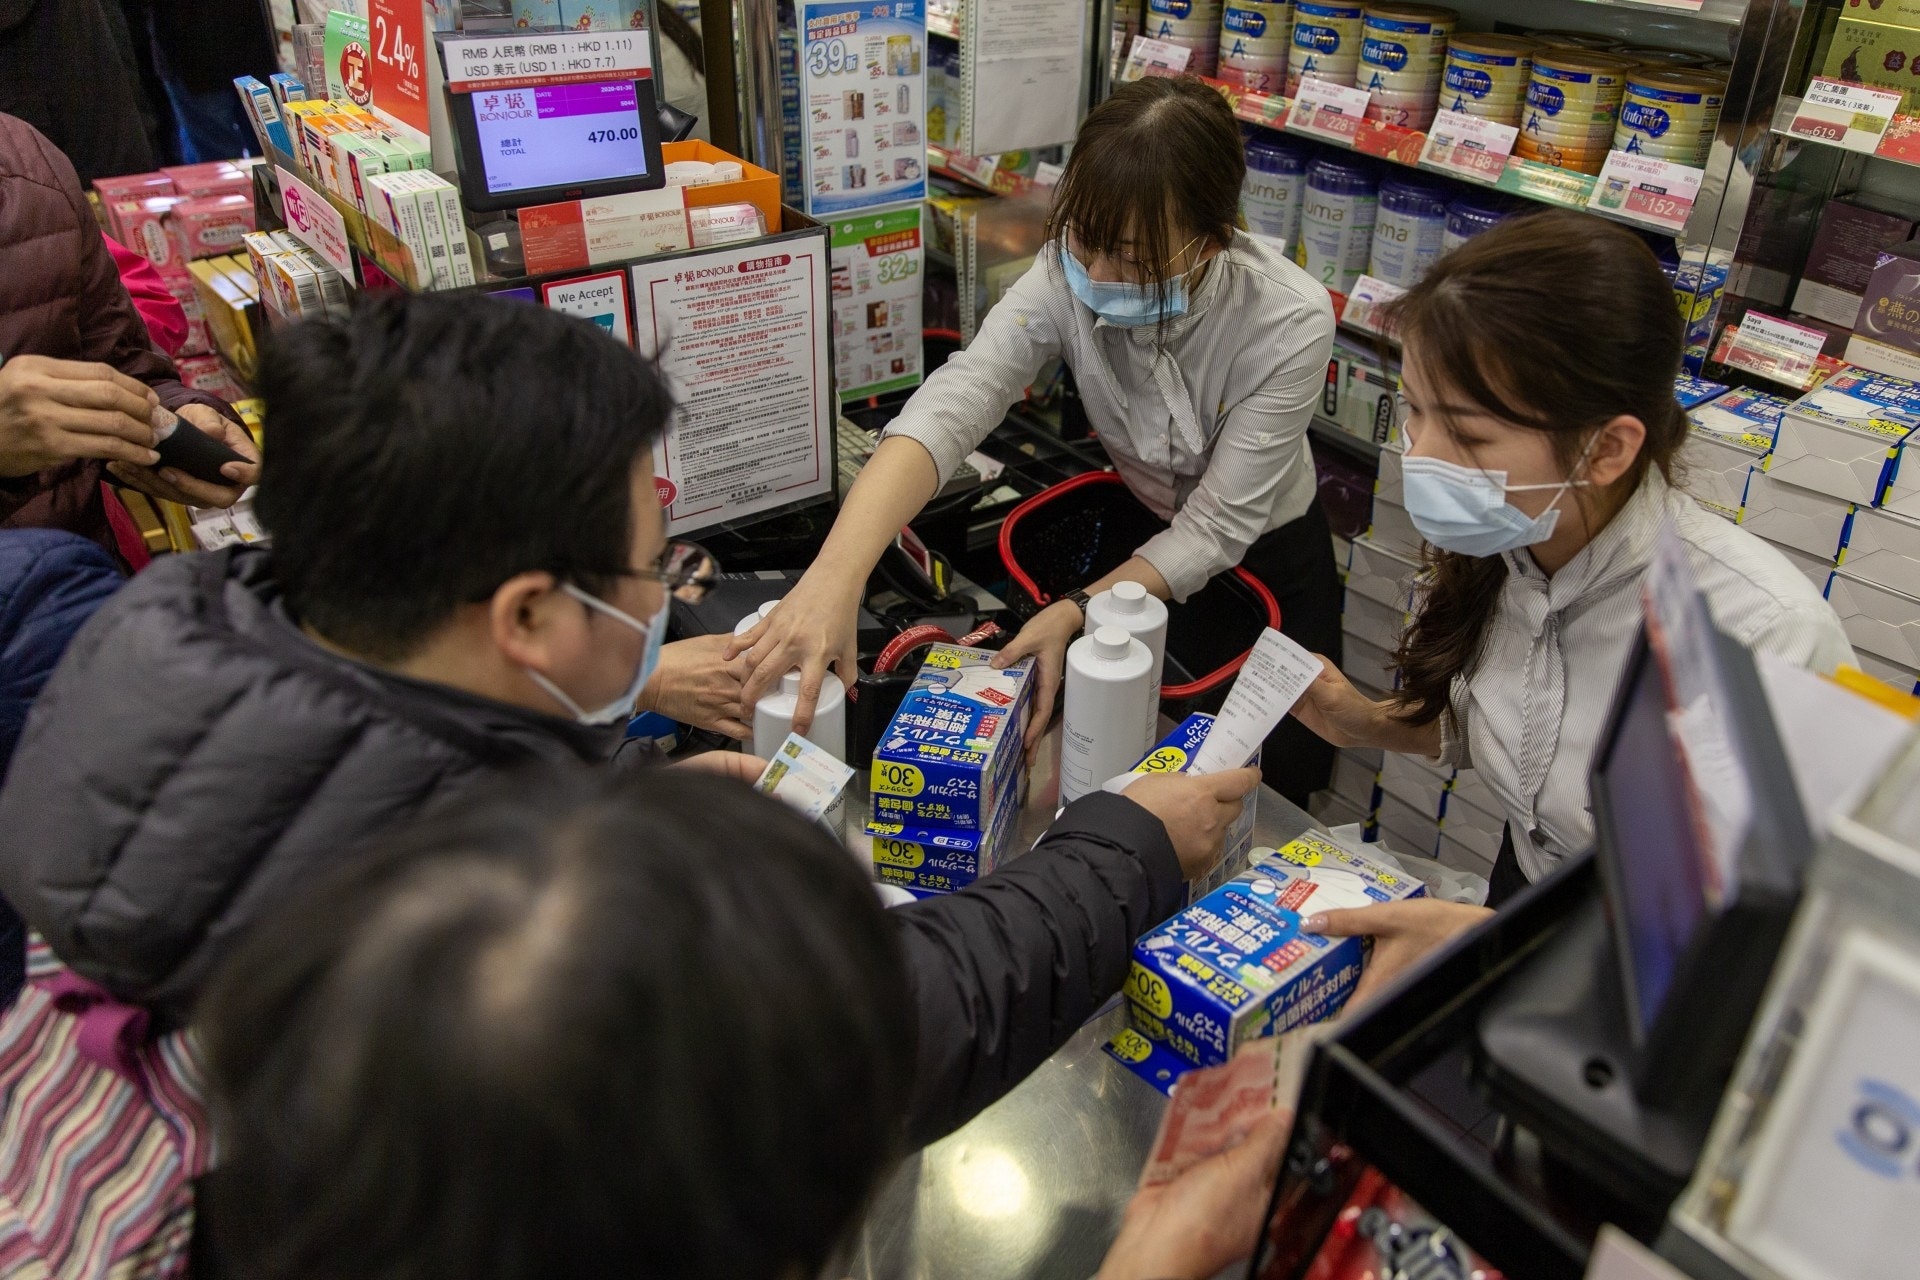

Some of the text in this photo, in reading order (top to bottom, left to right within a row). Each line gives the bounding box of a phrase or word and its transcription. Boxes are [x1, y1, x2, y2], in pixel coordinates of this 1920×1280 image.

[376, 15, 419, 80] 2.4%
[463, 47, 488, 59] RMB
[492, 44, 527, 59] 人民幣
[529, 43, 557, 57] (RMB
[578, 41, 601, 52] HKD
[605, 38, 632, 51] 1.11)
[465, 66, 490, 78] USD
[493, 62, 517, 76] 美元
[519, 60, 547, 74] (USD
[568, 57, 591, 69] HKD
[595, 55, 616, 68] 7.7)
[1813, 81, 1849, 96] 同仁集團
[479, 109, 533, 122] BONJOUR
[538, 106, 556, 114] SHOP
[1397, 110, 1409, 127] 2
[1622, 106, 1665, 130] Enfakid
[1326, 115, 1349, 132] 228
[1812, 125, 1837, 140] 619
[588, 127, 638, 144] 470.00
[500, 147, 526, 157] TOTAL
[1551, 151, 1563, 168] 3
[1469, 154, 1493, 170] 188
[655, 208, 682, 220] BONJOUR
[1648, 196, 1677, 217] 152
[707, 215, 736, 227] BONJOUR
[696, 264, 735, 279] BONJOUR
[747, 256, 783, 271] 購物指南
[1321, 265, 1336, 285] 2
[558, 285, 615, 304] We Accept
[1746, 315, 1762, 326] Saya
[914, 696, 973, 712] サージカルマスク
[896, 712, 969, 735] 細菌飛沫
[924, 705, 973, 726] 対策に
[892, 725, 961, 746] ウイルス
[1185, 716, 1210, 740] マスク
[1146, 750, 1175, 770] 30
[888, 765, 915, 788] 30
[946, 777, 978, 790] マスク
[878, 784, 914, 795] ふつうサイズ
[927, 784, 978, 800] サージカル
[878, 796, 915, 812] 個包装
[917, 809, 952, 820] マスクを
[889, 838, 915, 861] 30
[946, 851, 977, 865] マスク
[881, 866, 916, 881] 個包装
[927, 857, 977, 874] サージカル
[1181, 905, 1264, 956] 細菌飛沫
[1224, 904, 1281, 944] 対策に
[1163, 919, 1242, 970] ウイルス
[1137, 971, 1164, 1005] 30
[1270, 965, 1326, 1016] ウイルス
[1174, 1011, 1225, 1053] サージカル
[1192, 1011, 1226, 1042] マスク
